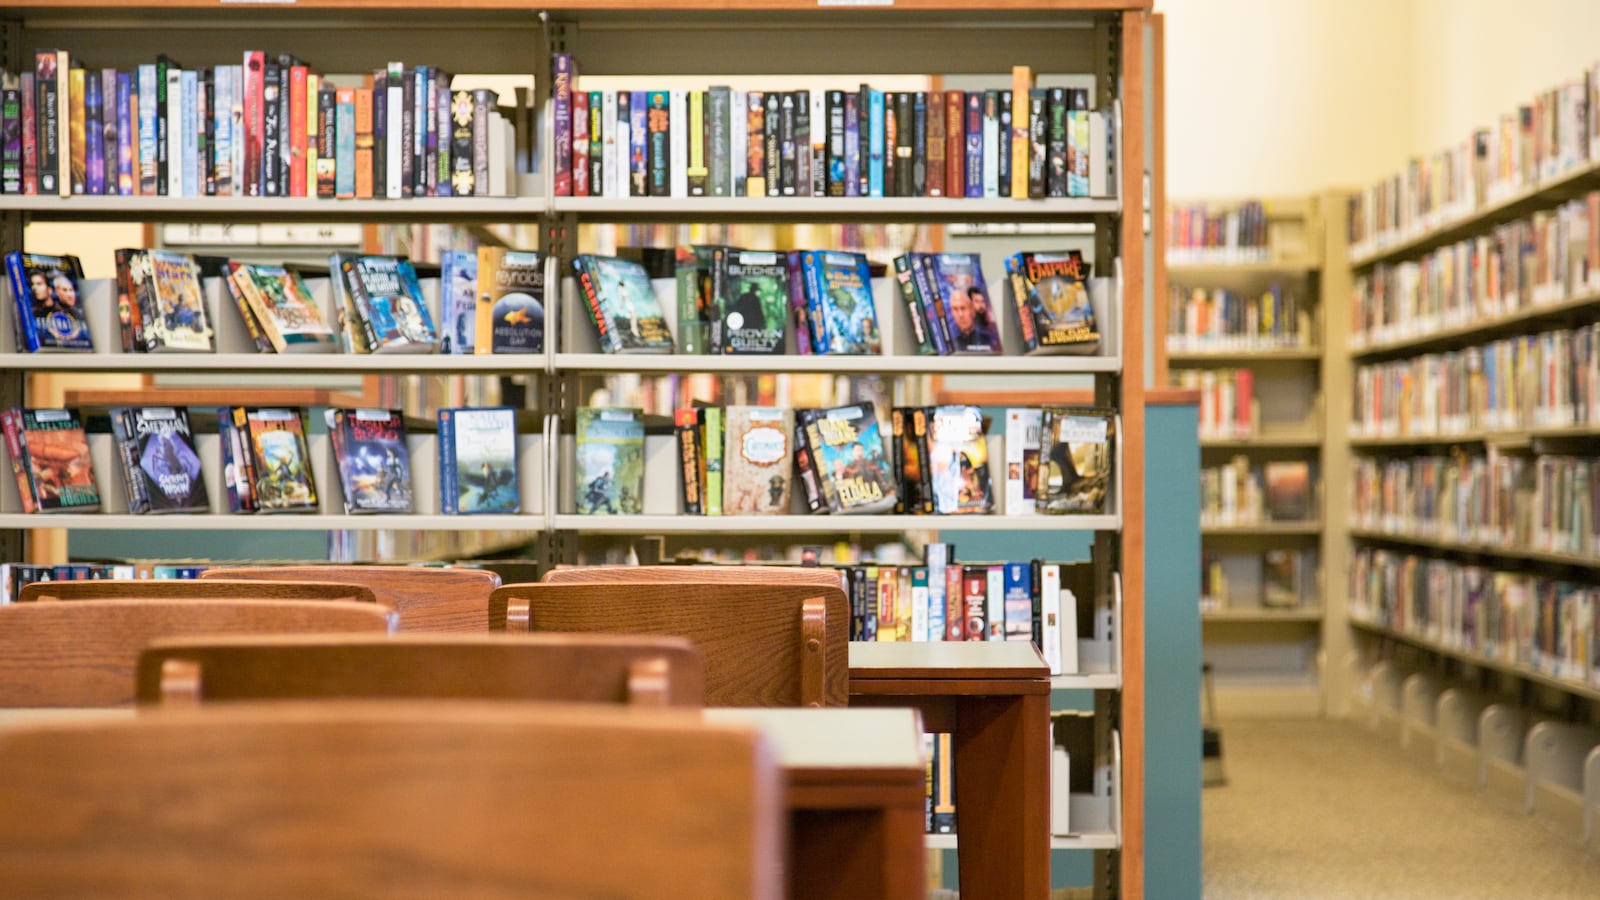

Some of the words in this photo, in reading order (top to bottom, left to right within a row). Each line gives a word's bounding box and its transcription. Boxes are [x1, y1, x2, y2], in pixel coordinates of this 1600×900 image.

[728, 265, 785, 279] BUTCHER
[1028, 258, 1085, 284] EMPIRE
[495, 269, 544, 286] reynolds
[580, 272, 608, 335] CARNIVAL
[494, 326, 543, 337] ABSOLUTION
[727, 328, 784, 338] PROVEN
[509, 336, 527, 345] GAP
[730, 337, 778, 348] GUILTY
